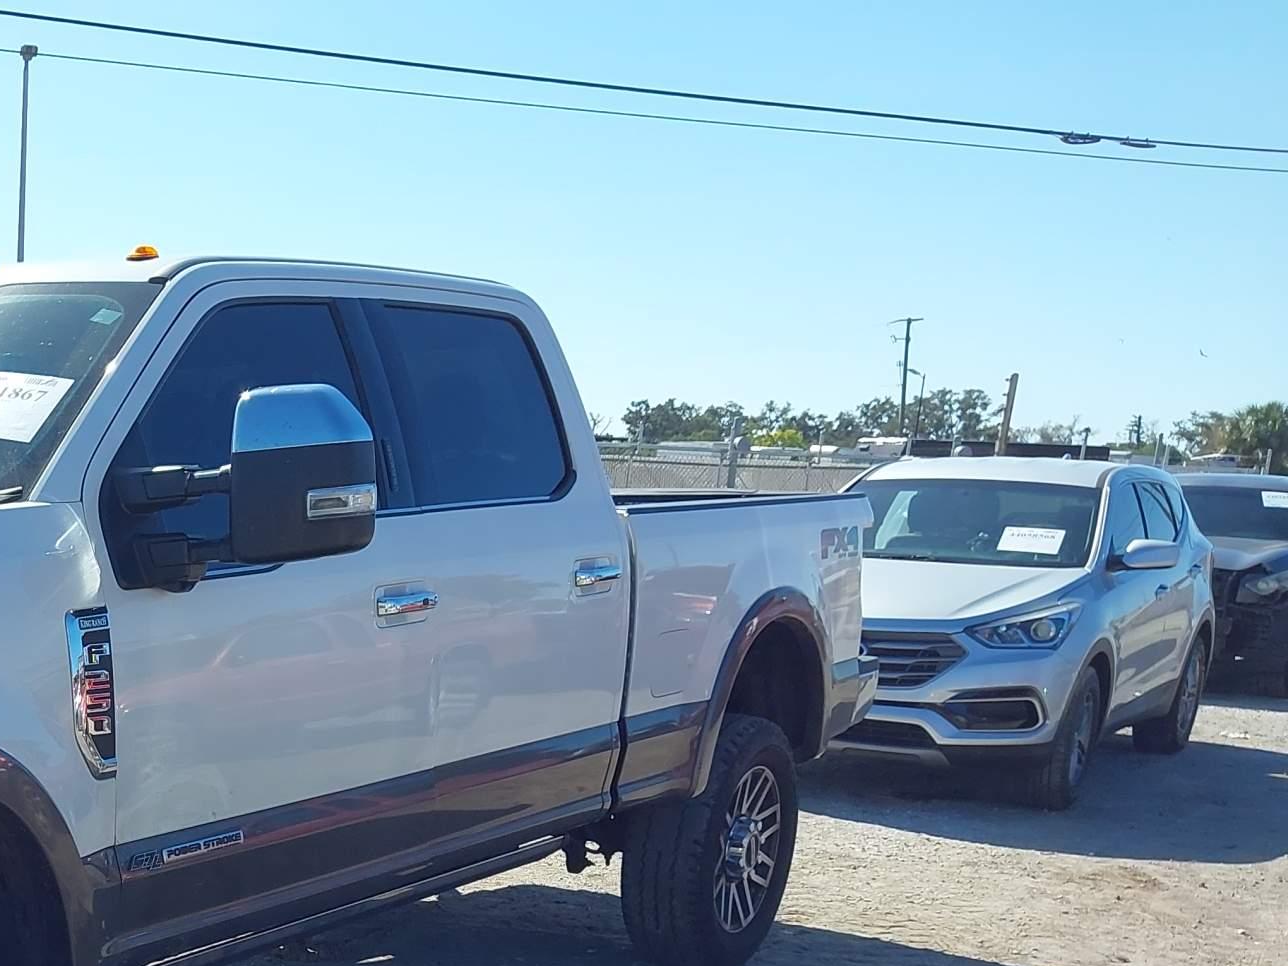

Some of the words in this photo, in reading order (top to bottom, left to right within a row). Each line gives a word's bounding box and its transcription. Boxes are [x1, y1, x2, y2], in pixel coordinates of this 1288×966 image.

[821, 526, 859, 560] FX4
[166, 843, 202, 859] POWER
[202, 831, 242, 851] STROKE
